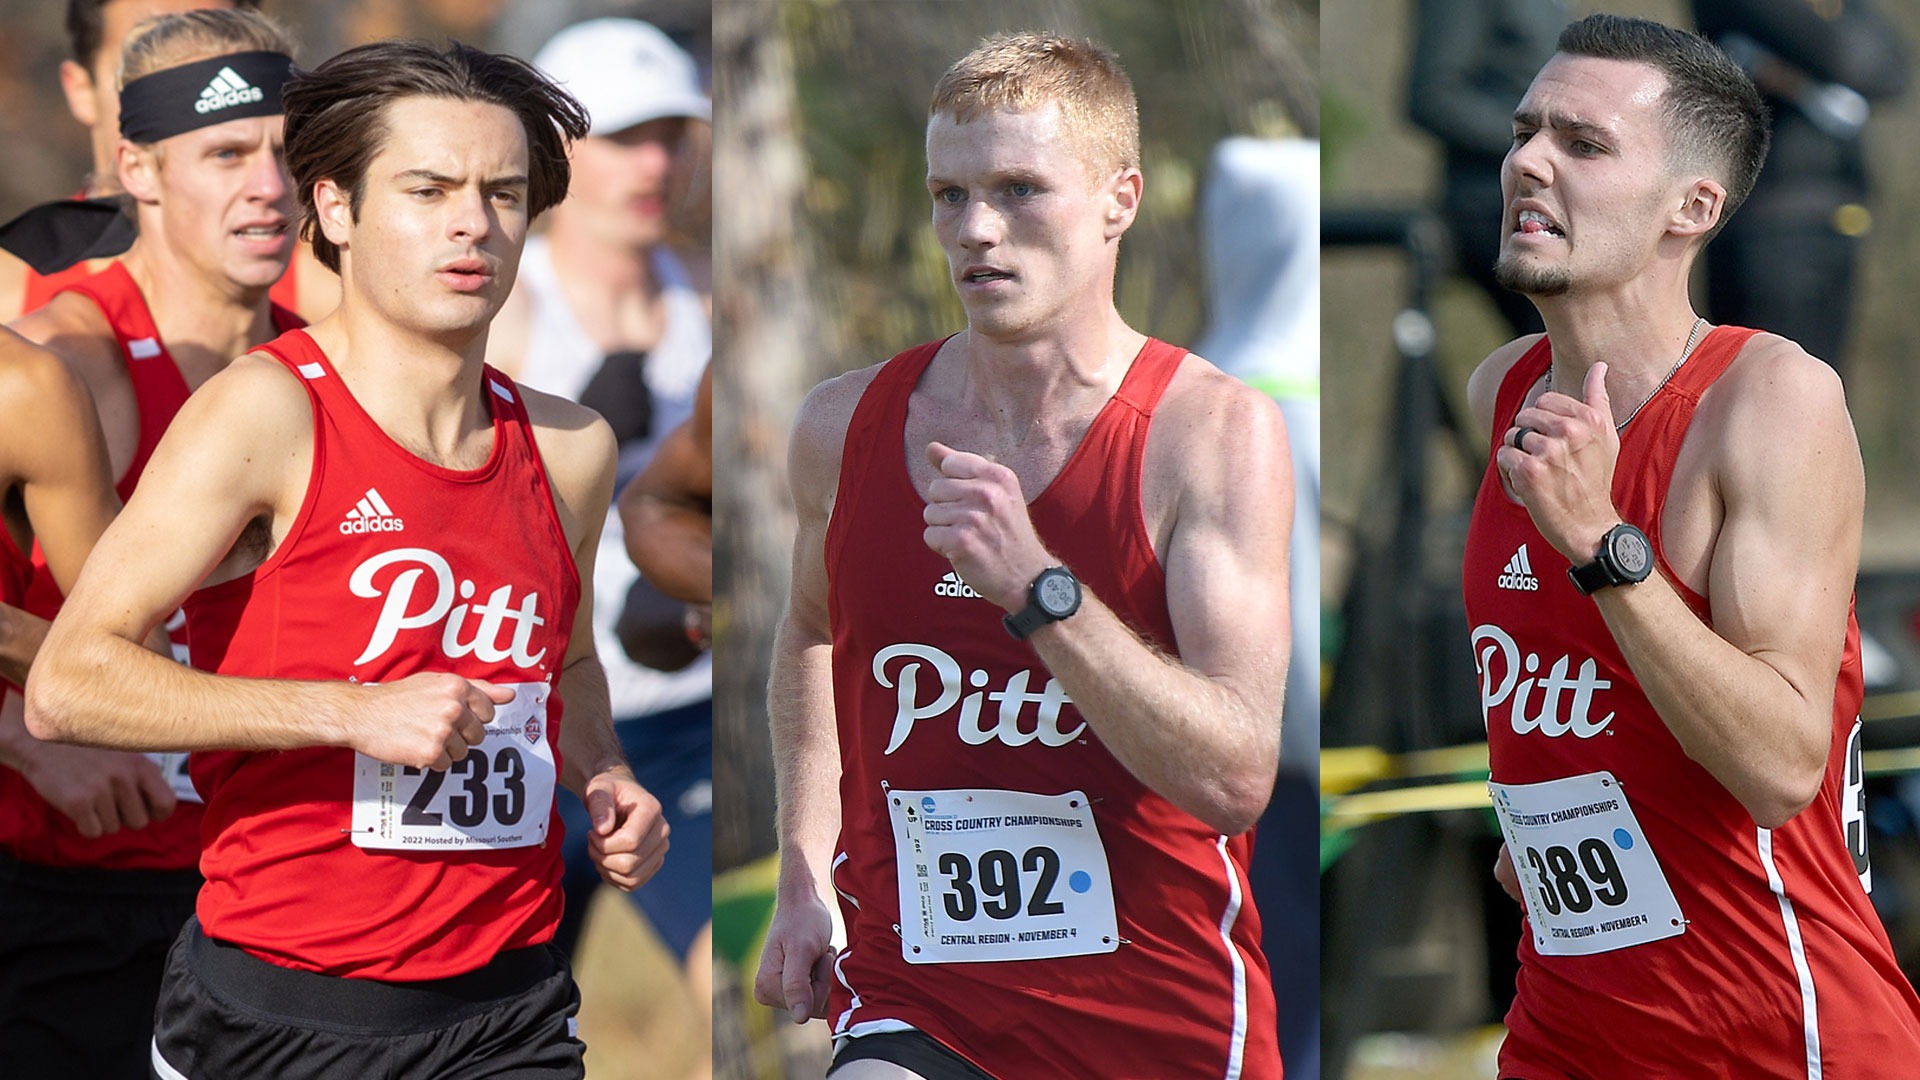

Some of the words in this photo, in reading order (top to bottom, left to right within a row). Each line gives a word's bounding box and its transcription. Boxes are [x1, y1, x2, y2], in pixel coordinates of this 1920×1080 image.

[194, 86, 264, 114] adidas
[339, 516, 404, 534] adidas
[934, 580, 983, 598] adid
[1498, 572, 1539, 591] adidas
[349, 547, 547, 669] Pitt
[1471, 624, 1615, 738] Pitt
[872, 643, 1087, 755] Pitt
[485, 725, 522, 738] ampionships
[401, 746, 526, 827] 233
[925, 820, 953, 831] CROSS
[955, 816, 1002, 831] COUNTRY
[1004, 815, 1083, 828] CHAMPIONSHIPS
[1551, 799, 1619, 823] CHAMPIONSHIPS
[402, 836, 422, 844] 2022
[425, 836, 452, 844] Hosted
[455, 836, 464, 846] by
[466, 836, 496, 844] Missouri
[497, 834, 523, 843] Southern
[938, 846, 1065, 922] 392
[1526, 837, 1629, 916] 389
[940, 935, 976, 945] CENTRAL
[978, 933, 1010, 944] REGION
[1018, 928, 1068, 942] NOVEMBER
[1070, 927, 1077, 938] 4
[1570, 925, 1596, 938] REGION
[1600, 915, 1642, 933] NOVEMBER
[1641, 914, 1648, 924] 4
